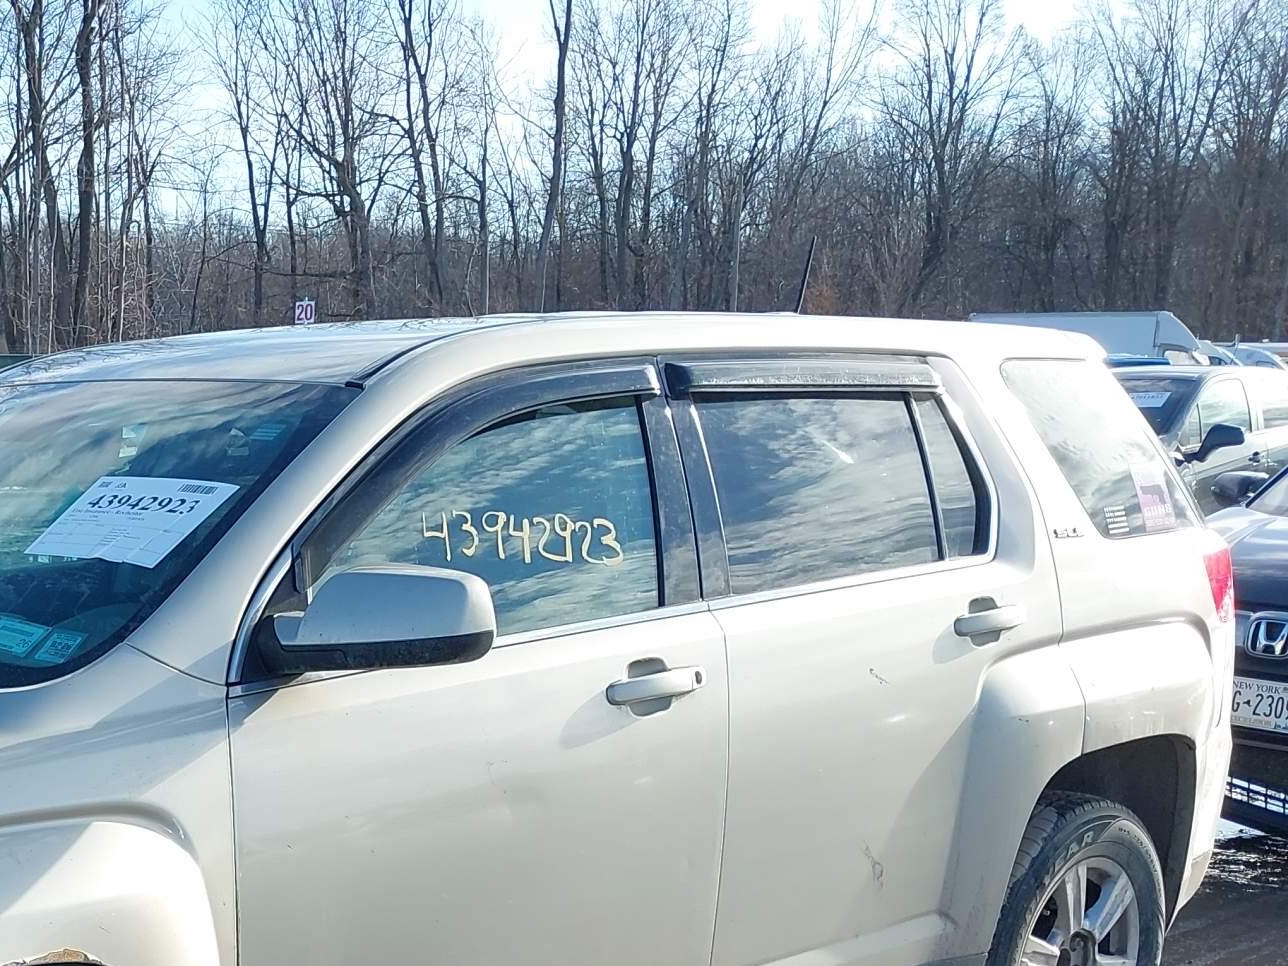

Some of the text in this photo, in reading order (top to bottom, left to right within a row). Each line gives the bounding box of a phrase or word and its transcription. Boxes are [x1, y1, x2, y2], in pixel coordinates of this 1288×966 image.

[297, 303, 313, 321] 20
[87, 494, 201, 515] 43942923
[421, 509, 624, 566] 43942923
[1232, 680, 1281, 694] NEW YORK
